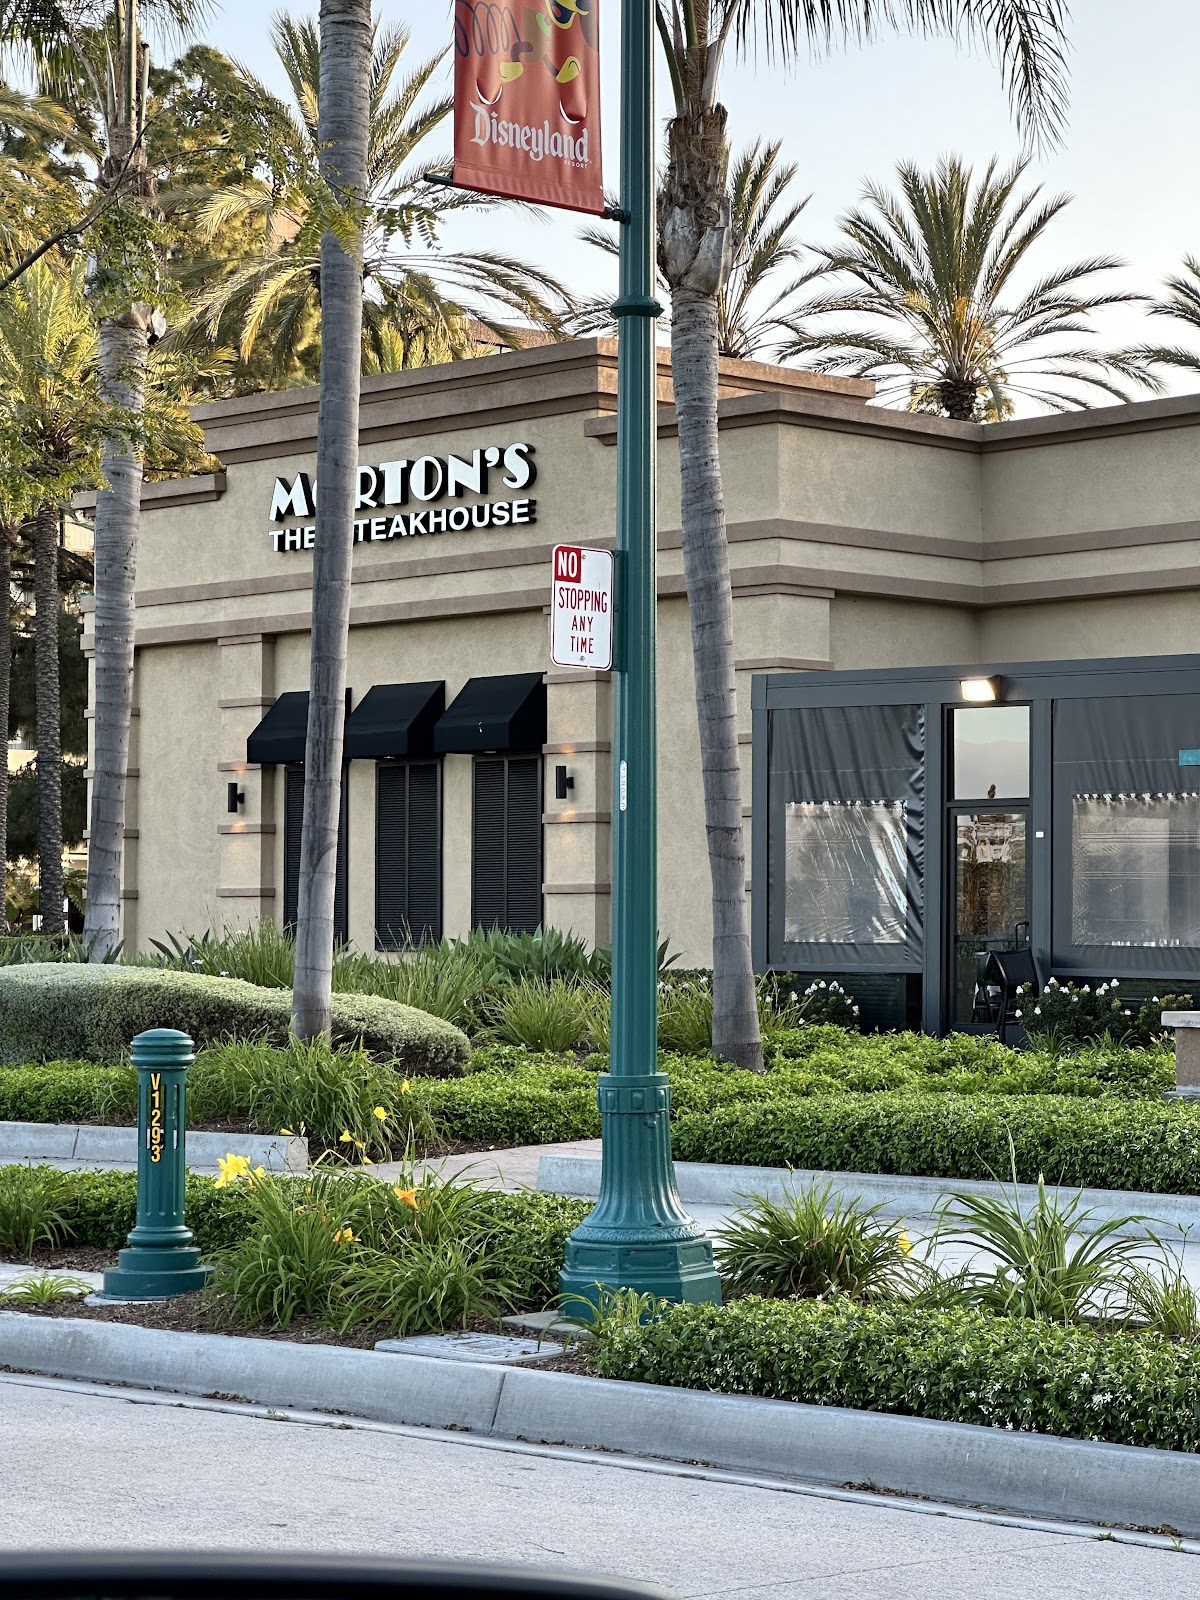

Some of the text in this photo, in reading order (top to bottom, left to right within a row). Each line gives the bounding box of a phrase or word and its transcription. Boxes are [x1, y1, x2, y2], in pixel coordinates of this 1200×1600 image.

[470, 101, 589, 161] Disneyland
[563, 160, 588, 169] RESORT
[268, 442, 531, 521] MRTON'S
[268, 499, 531, 552] THE TEAKHOUSE
[558, 551, 578, 578] NO
[558, 586, 608, 613] STOPPING
[571, 615, 594, 633] ANY
[570, 635, 594, 654] TIME
[150, 1072, 161, 1163] V1293
